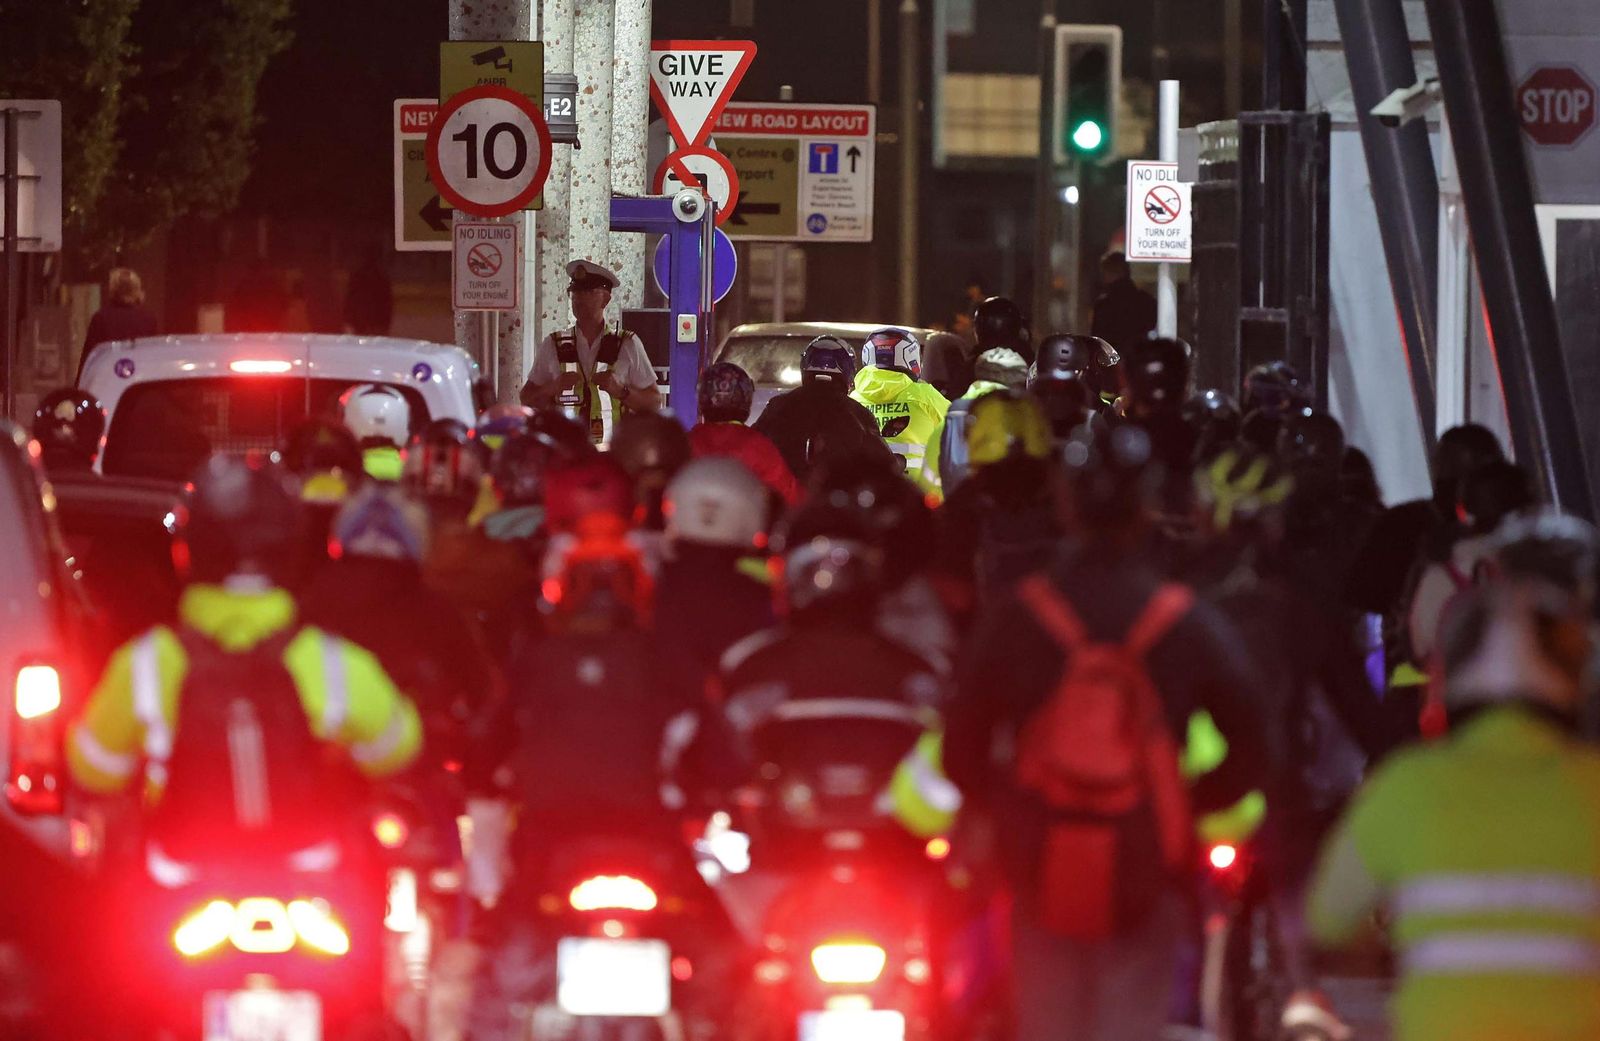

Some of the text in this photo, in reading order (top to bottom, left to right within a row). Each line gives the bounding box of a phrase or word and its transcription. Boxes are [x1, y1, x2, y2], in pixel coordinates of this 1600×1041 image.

[658, 54, 724, 76] GIVE
[669, 81, 717, 97] WAY
[550, 97, 572, 116] E2
[1522, 88, 1590, 123] STOP
[751, 114, 798, 129] ROAD
[801, 115, 865, 131] LAYOUT
[452, 121, 528, 180] 10
[1136, 168, 1177, 181] NO IDLI
[460, 228, 512, 240] NO IDLING
[1144, 228, 1181, 237] TURN OFF
[1137, 239, 1188, 250] YOUR ENGINE
